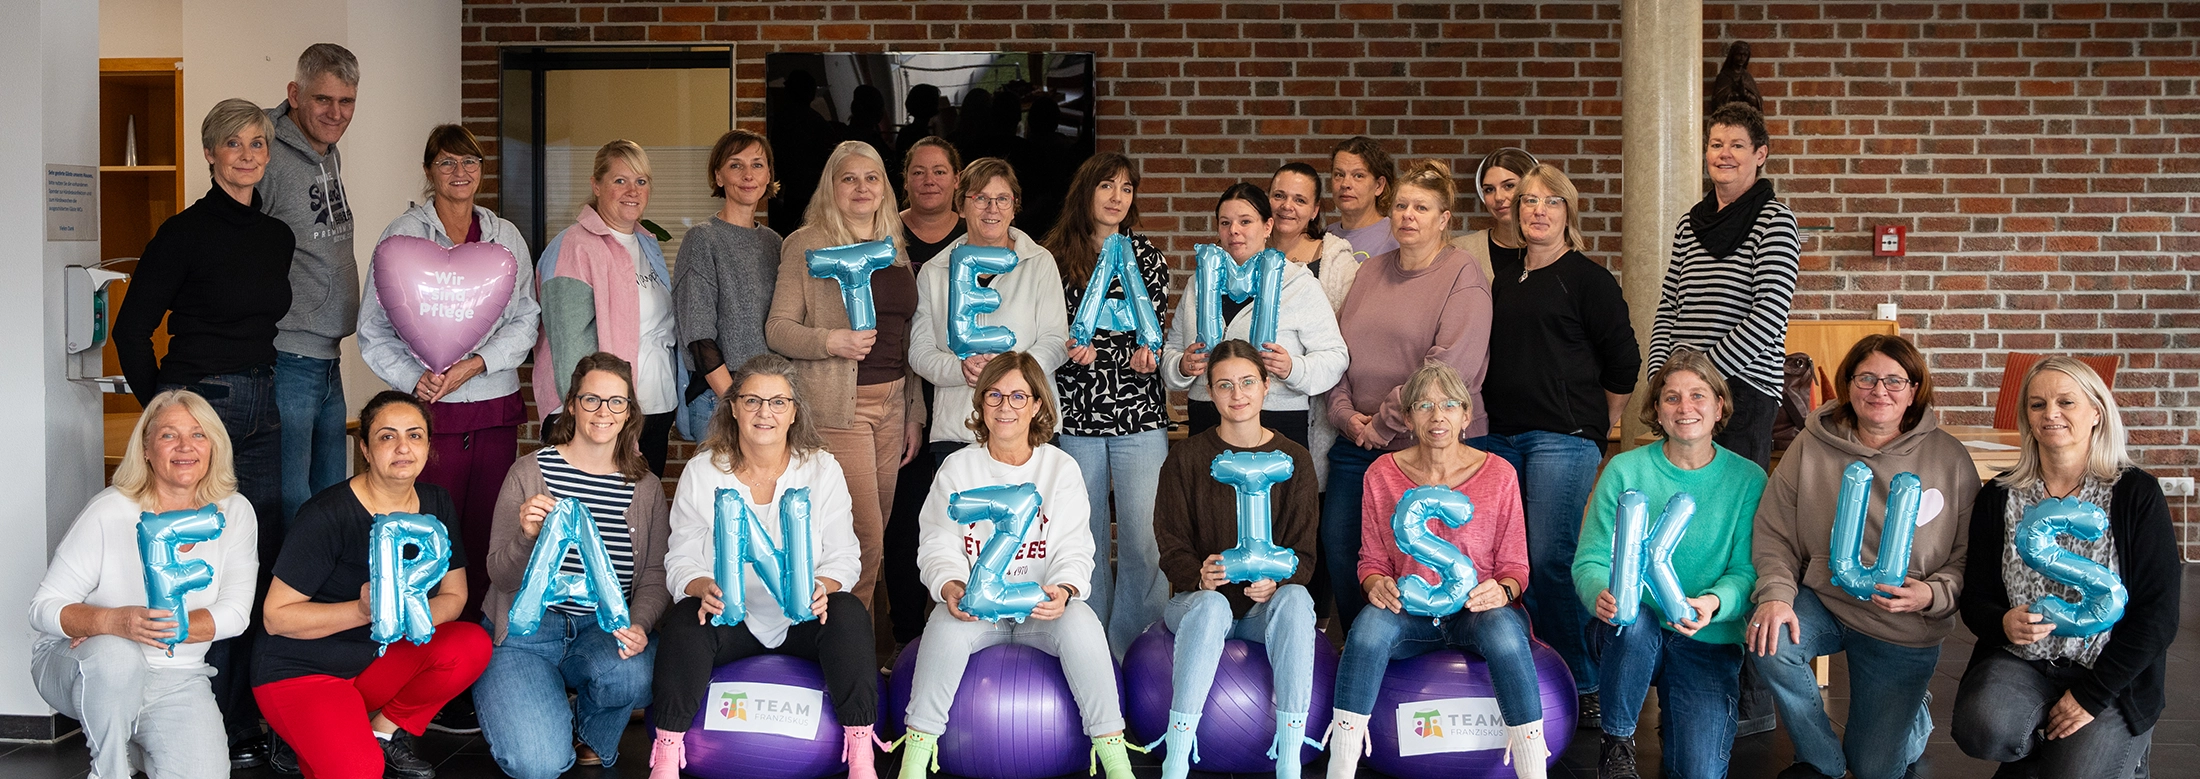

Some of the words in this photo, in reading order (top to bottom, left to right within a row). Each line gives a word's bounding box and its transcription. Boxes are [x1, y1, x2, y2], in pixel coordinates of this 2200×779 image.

[434, 271, 465, 286] Wir
[431, 286, 466, 302] sind
[805, 233, 1286, 361] TEAM
[419, 302, 475, 323] Pflege
[136, 449, 2129, 648] FRANZISKUS
[754, 698, 811, 717] TEAM
[754, 712, 809, 727] FRANZISKUS
[1447, 713, 1504, 728] TEAM
[1450, 727, 1504, 737] FRANZISKUS
